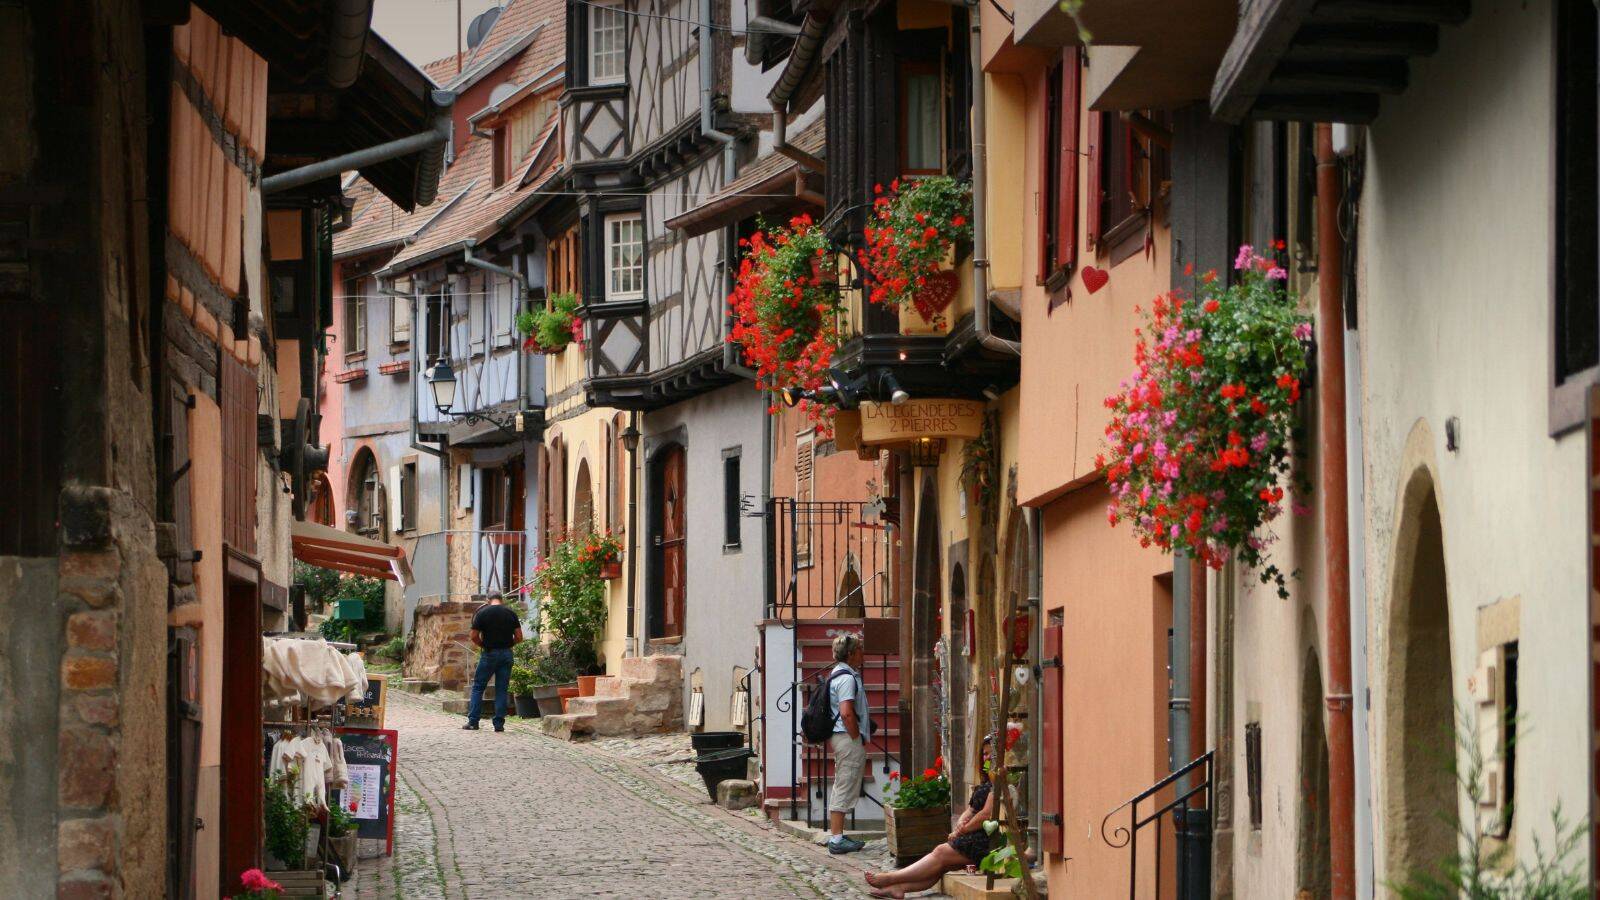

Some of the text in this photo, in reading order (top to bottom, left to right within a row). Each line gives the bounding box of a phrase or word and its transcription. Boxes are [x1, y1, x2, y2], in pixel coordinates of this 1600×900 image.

[867, 405, 884, 418] LA
[949, 403, 976, 416] DES
[890, 418, 958, 432] 2 PIERRES
